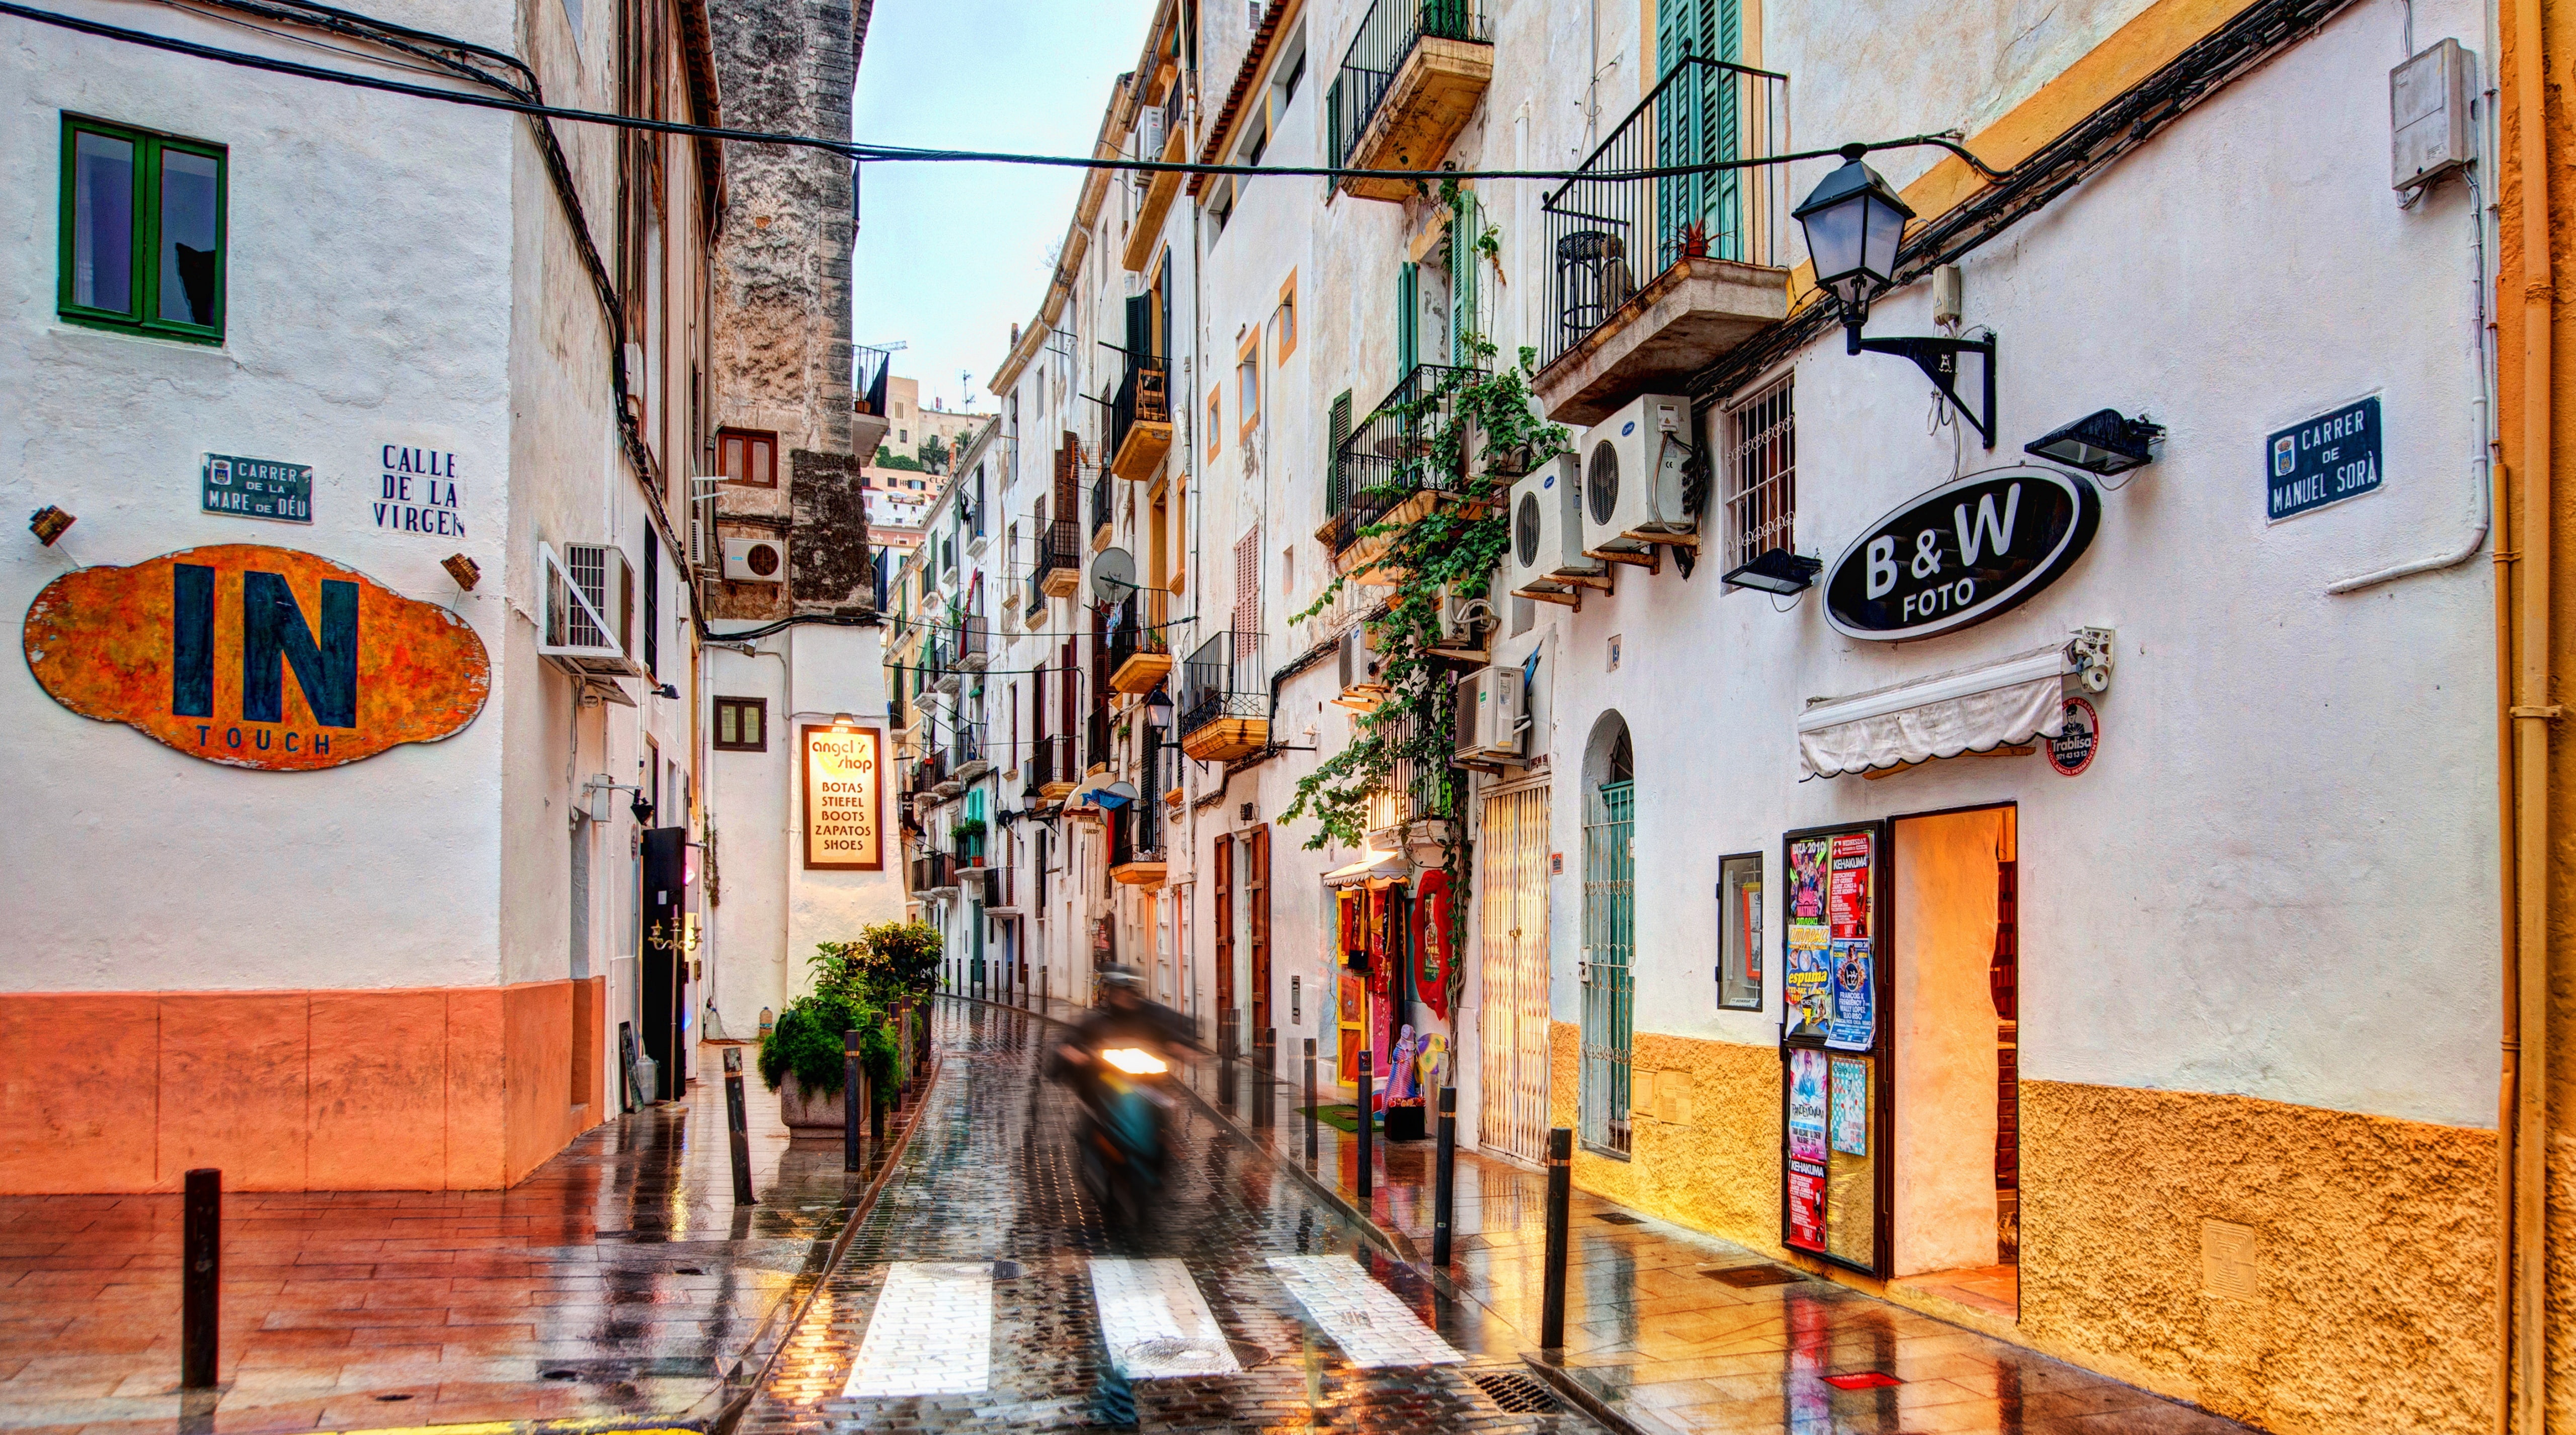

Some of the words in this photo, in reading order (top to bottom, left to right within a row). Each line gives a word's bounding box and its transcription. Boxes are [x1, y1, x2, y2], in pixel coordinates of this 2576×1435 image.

[2302, 410, 2364, 450] CARRER
[382, 445, 457, 478] CALLE
[2322, 447, 2340, 464] DE
[238, 463, 297, 482] CARRER
[2274, 473, 2326, 513] MANUEL
[2338, 451, 2377, 492] SORÀ
[246, 481, 263, 490] DE
[269, 484, 285, 493] LA
[382, 474, 412, 501] DE
[430, 480, 457, 508] LA
[209, 490, 250, 510] MARE
[256, 504, 272, 513] DE
[278, 495, 305, 517] DÉU
[374, 503, 465, 537] VIRGEN
[1903, 577, 1974, 622] FOTO
[173, 562, 359, 728] IN
[2077, 699, 2095, 721] ALARMA
[196, 725, 330, 755] TOUCH
[2052, 736, 2091, 752] Trablisa
[2048, 748, 2071, 775] VIGILANCIA
[2072, 734, 2098, 775] PERMANENTE
[838, 755, 872, 774] shop
[822, 782, 862, 793] BOTAS
[822, 797, 863, 807] STIEFEL
[822, 811, 864, 821] BOOTS
[816, 825, 870, 836] ZAPATOS
[824, 840, 863, 850] SHOES
[1833, 857, 1867, 870] KEHAKUMA
[1789, 971, 1827, 986] espuma
[1792, 1104, 1824, 1119] PANDEMONIUM
[1791, 1160, 1824, 1178] KEHAKUMA
